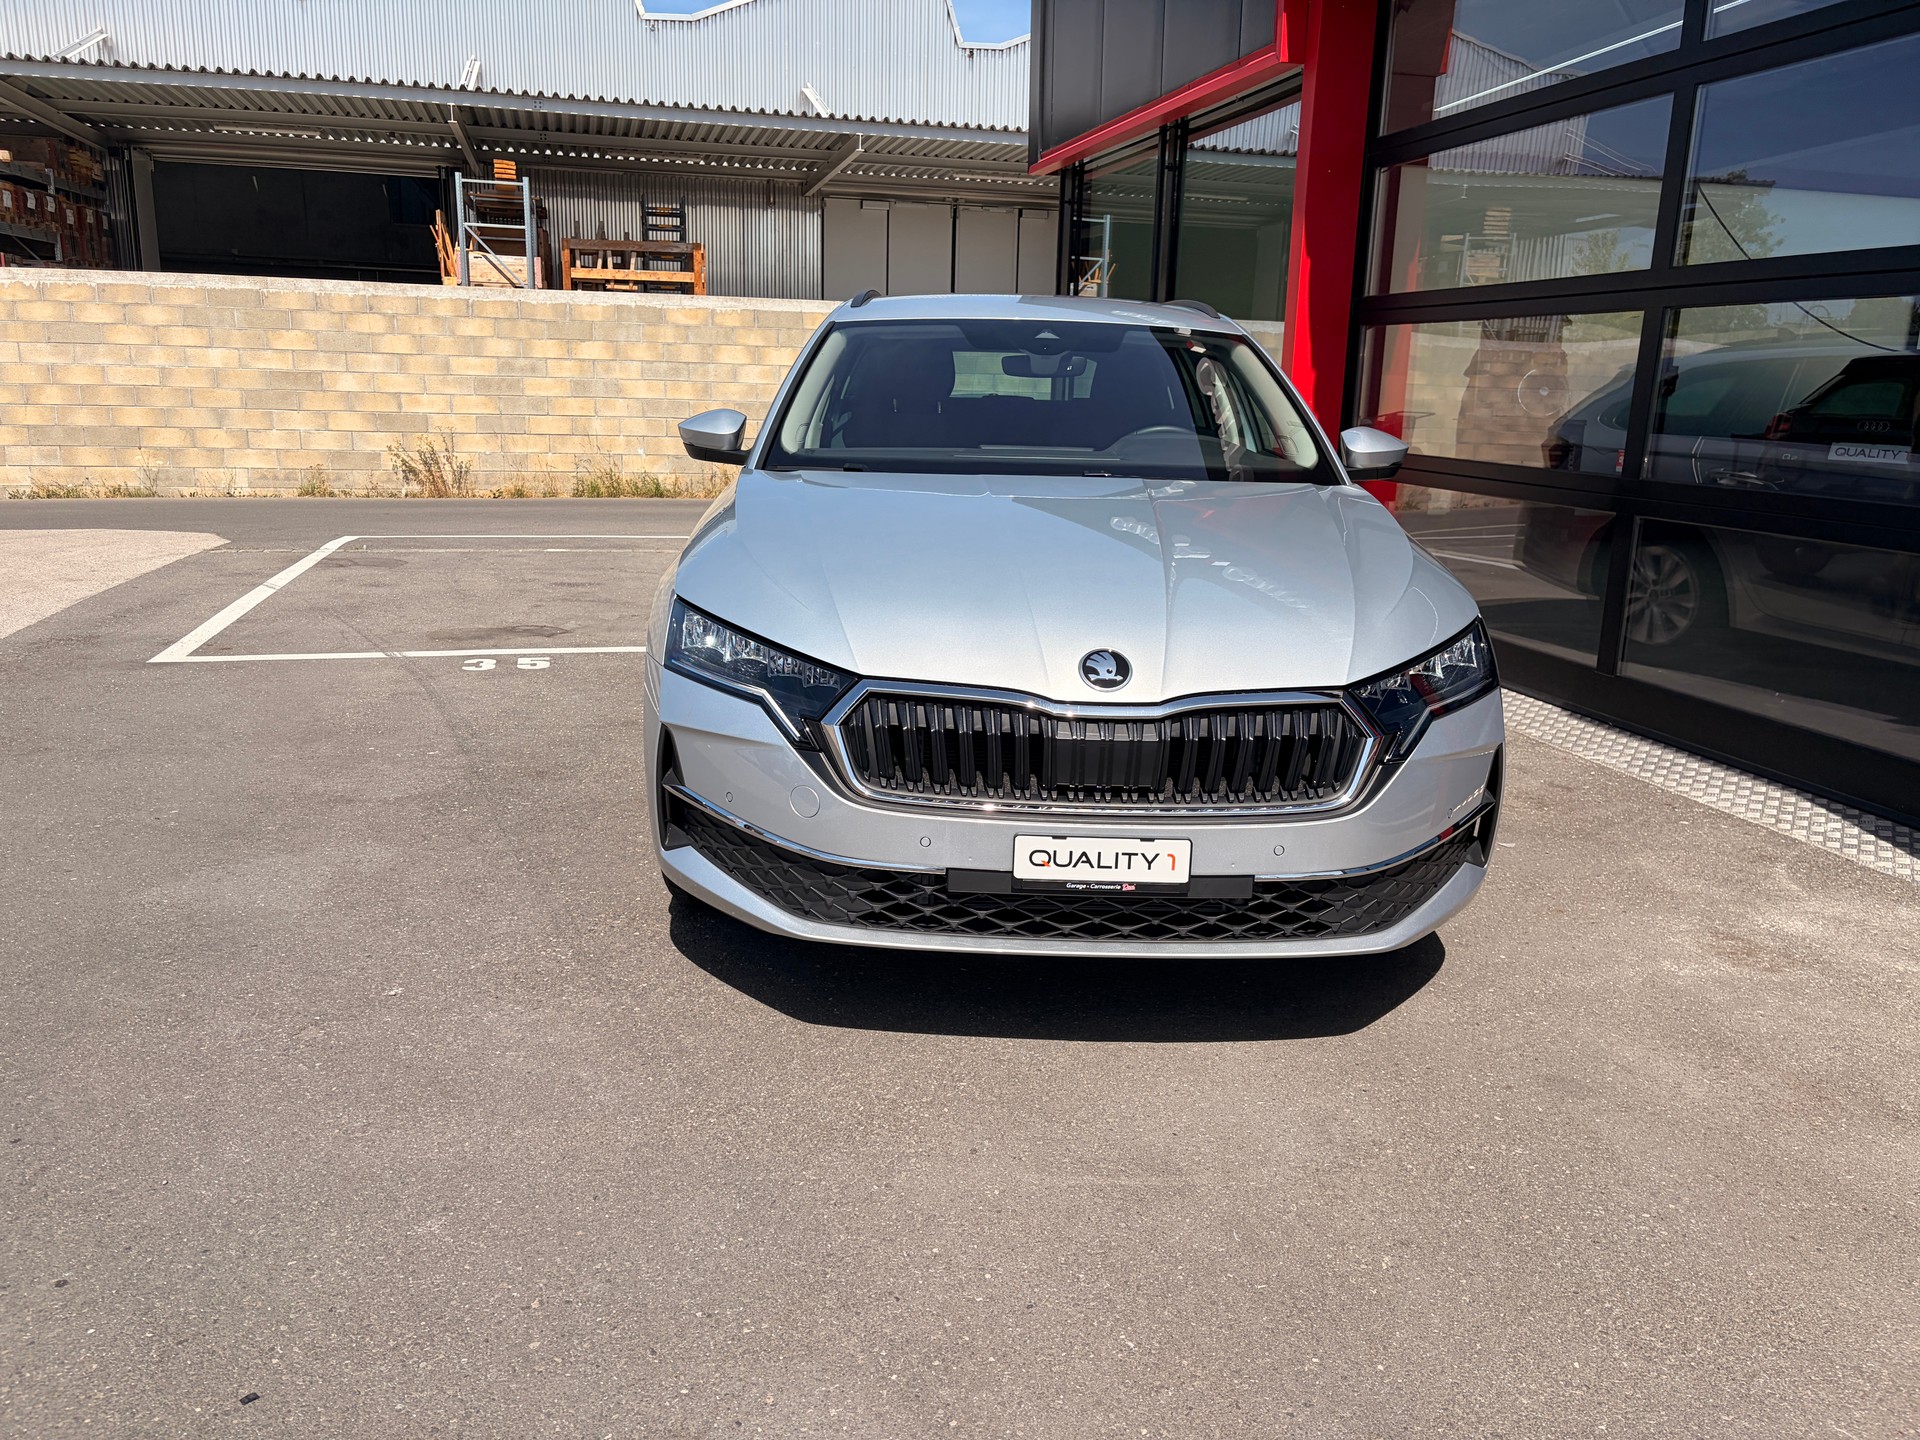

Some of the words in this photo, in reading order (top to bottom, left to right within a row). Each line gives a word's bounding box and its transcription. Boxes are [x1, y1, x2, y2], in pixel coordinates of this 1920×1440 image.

[1835, 447, 1902, 460] QUALITY
[462, 657, 551, 671] 35
[1029, 849, 1160, 870] QUALITY
[1167, 853, 1176, 871] 1
